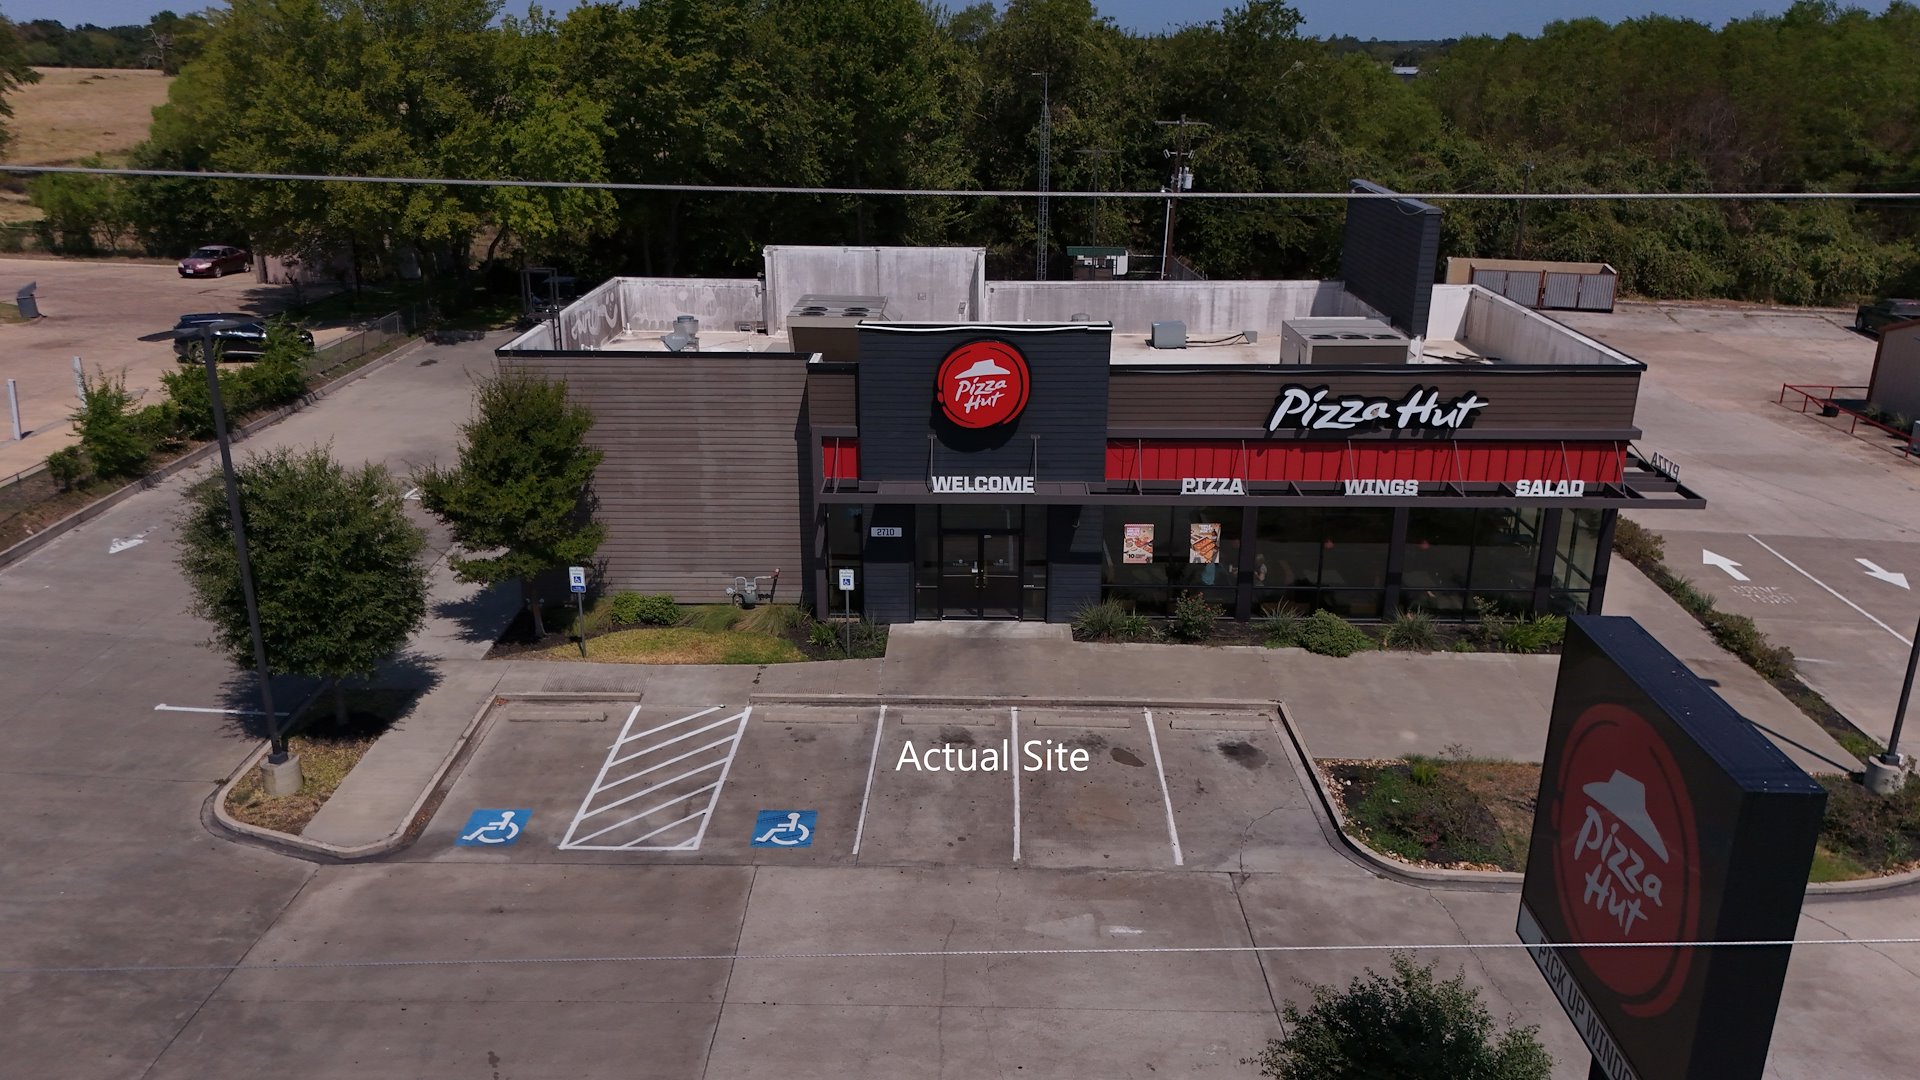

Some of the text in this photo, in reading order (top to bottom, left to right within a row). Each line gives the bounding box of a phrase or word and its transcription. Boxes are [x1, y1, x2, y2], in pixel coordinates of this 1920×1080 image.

[955, 377, 1008, 402] Pizza
[964, 393, 1005, 414] Hut
[1269, 388, 1489, 431] Pizza Hut
[931, 475, 1035, 493] WELCOME
[1180, 477, 1246, 496] PIZZA
[1344, 479, 1420, 497] WINGS
[1515, 479, 1585, 497] SALAD
[876, 528, 895, 536] 2710
[1573, 805, 1663, 907] Pizza
[1584, 864, 1648, 935] Hut
[1538, 937, 1567, 996] PICK
[1567, 986, 1585, 1019] UP
